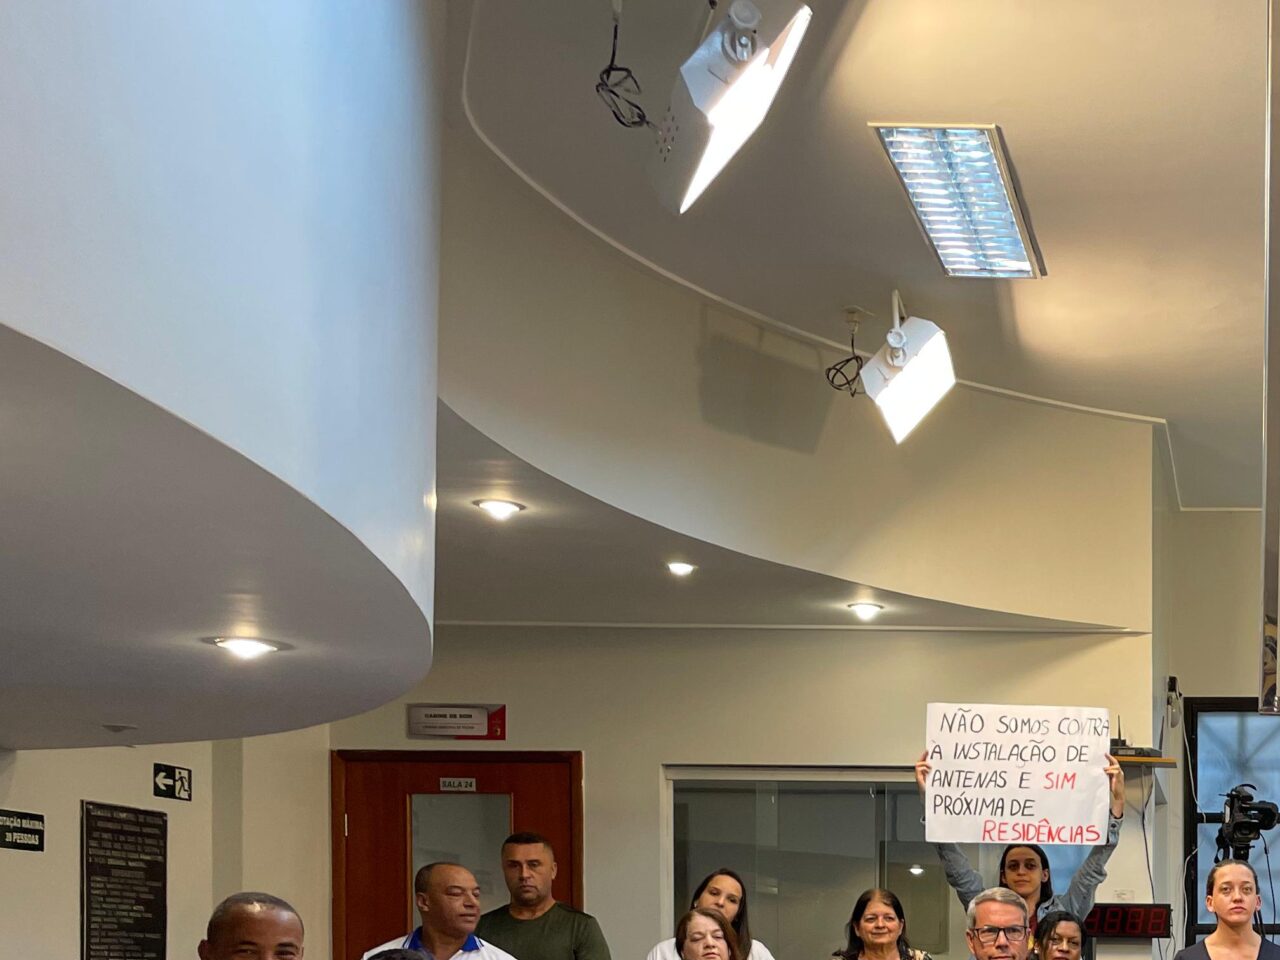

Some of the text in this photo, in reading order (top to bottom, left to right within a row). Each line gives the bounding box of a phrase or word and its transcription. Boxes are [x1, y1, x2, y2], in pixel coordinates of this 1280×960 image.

[940, 708, 984, 733] NÃO
[996, 715, 1050, 735] SOMOS
[953, 739, 1056, 768] INSTALAÇÃO
[1066, 745, 1089, 762] DE
[931, 769, 1077, 790] ANTENAS E SIM
[933, 792, 1035, 816] PRÓXIMA DE
[982, 818, 1100, 843] RESIDÊNCIAS
